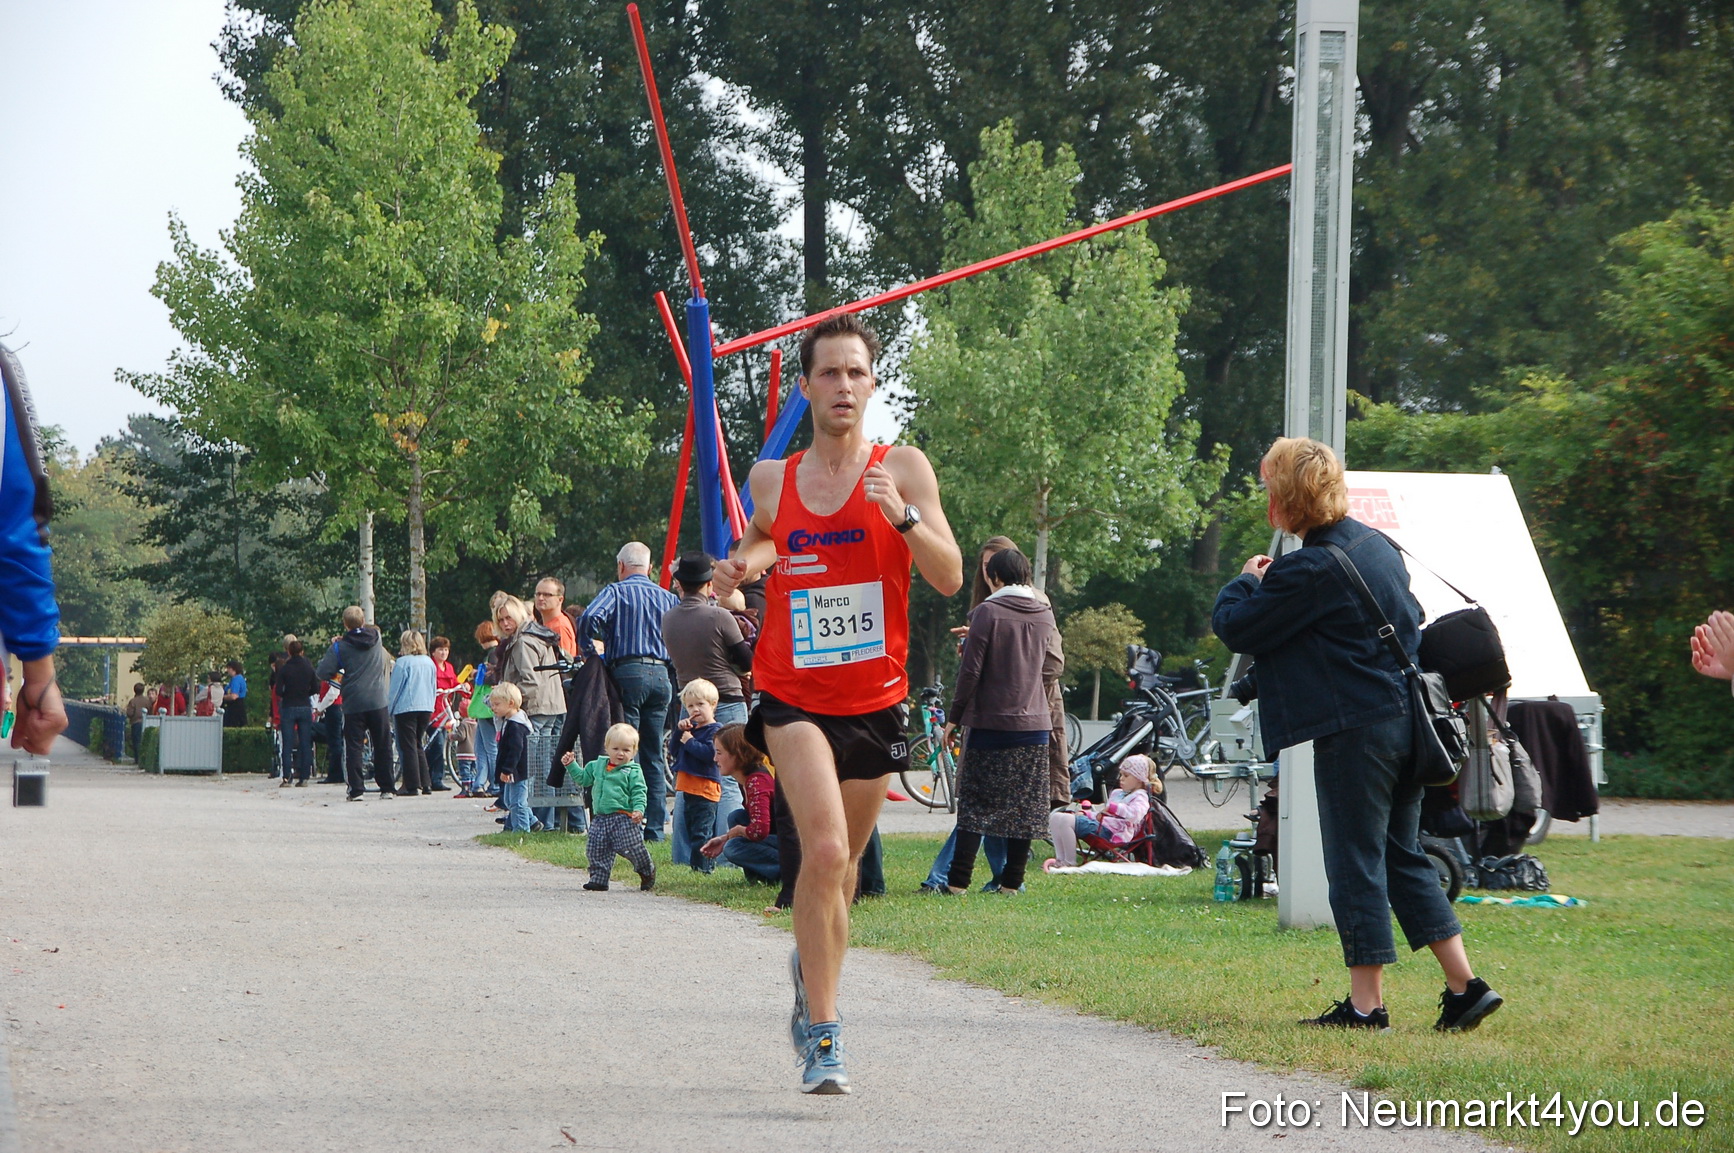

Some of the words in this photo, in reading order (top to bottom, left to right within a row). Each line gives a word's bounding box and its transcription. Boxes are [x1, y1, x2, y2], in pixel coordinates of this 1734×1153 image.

[787, 528, 865, 553] CONRAD
[814, 595, 850, 609] Marco
[798, 618, 804, 630] A
[818, 612, 874, 638] 3315
